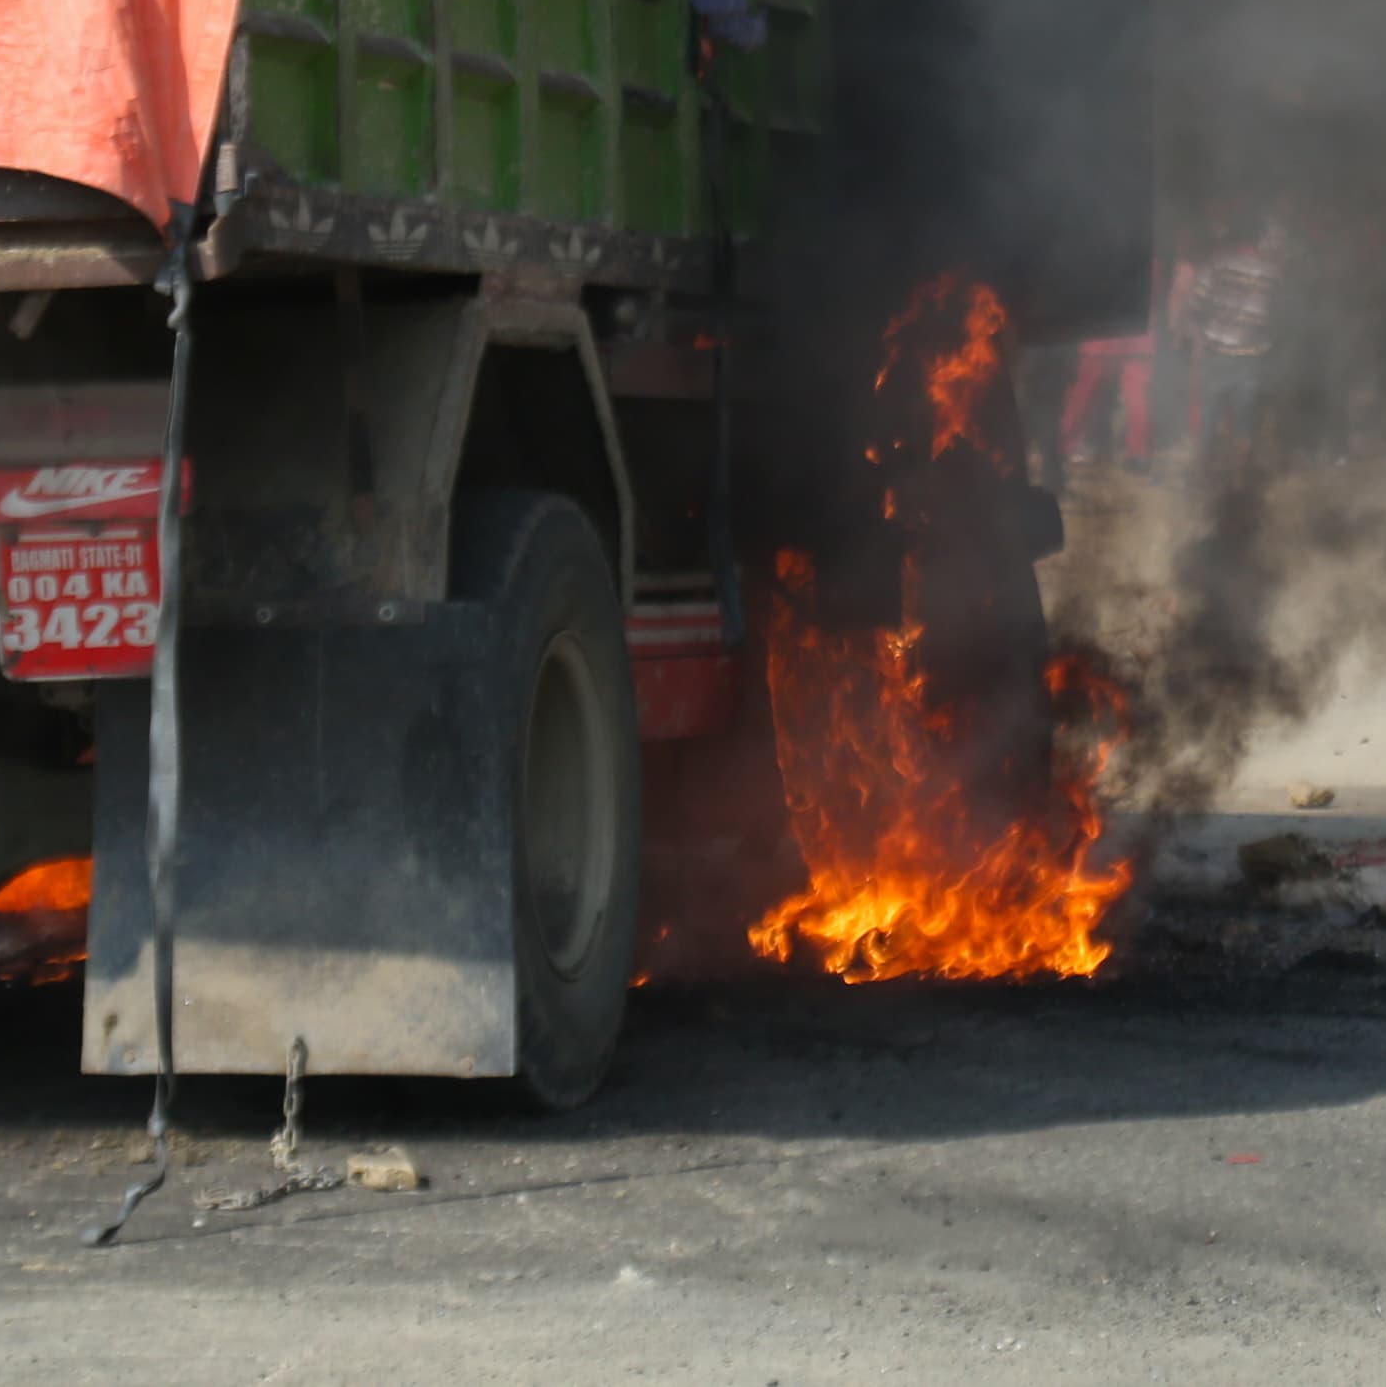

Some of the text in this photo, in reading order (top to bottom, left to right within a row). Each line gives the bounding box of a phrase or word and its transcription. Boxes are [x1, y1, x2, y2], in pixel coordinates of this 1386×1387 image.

[23, 467, 150, 496] NIKE
[10, 543, 143, 573] BAGMATI STATE-01
[8, 571, 149, 603] 004 KA
[3, 601, 159, 652] 3423
